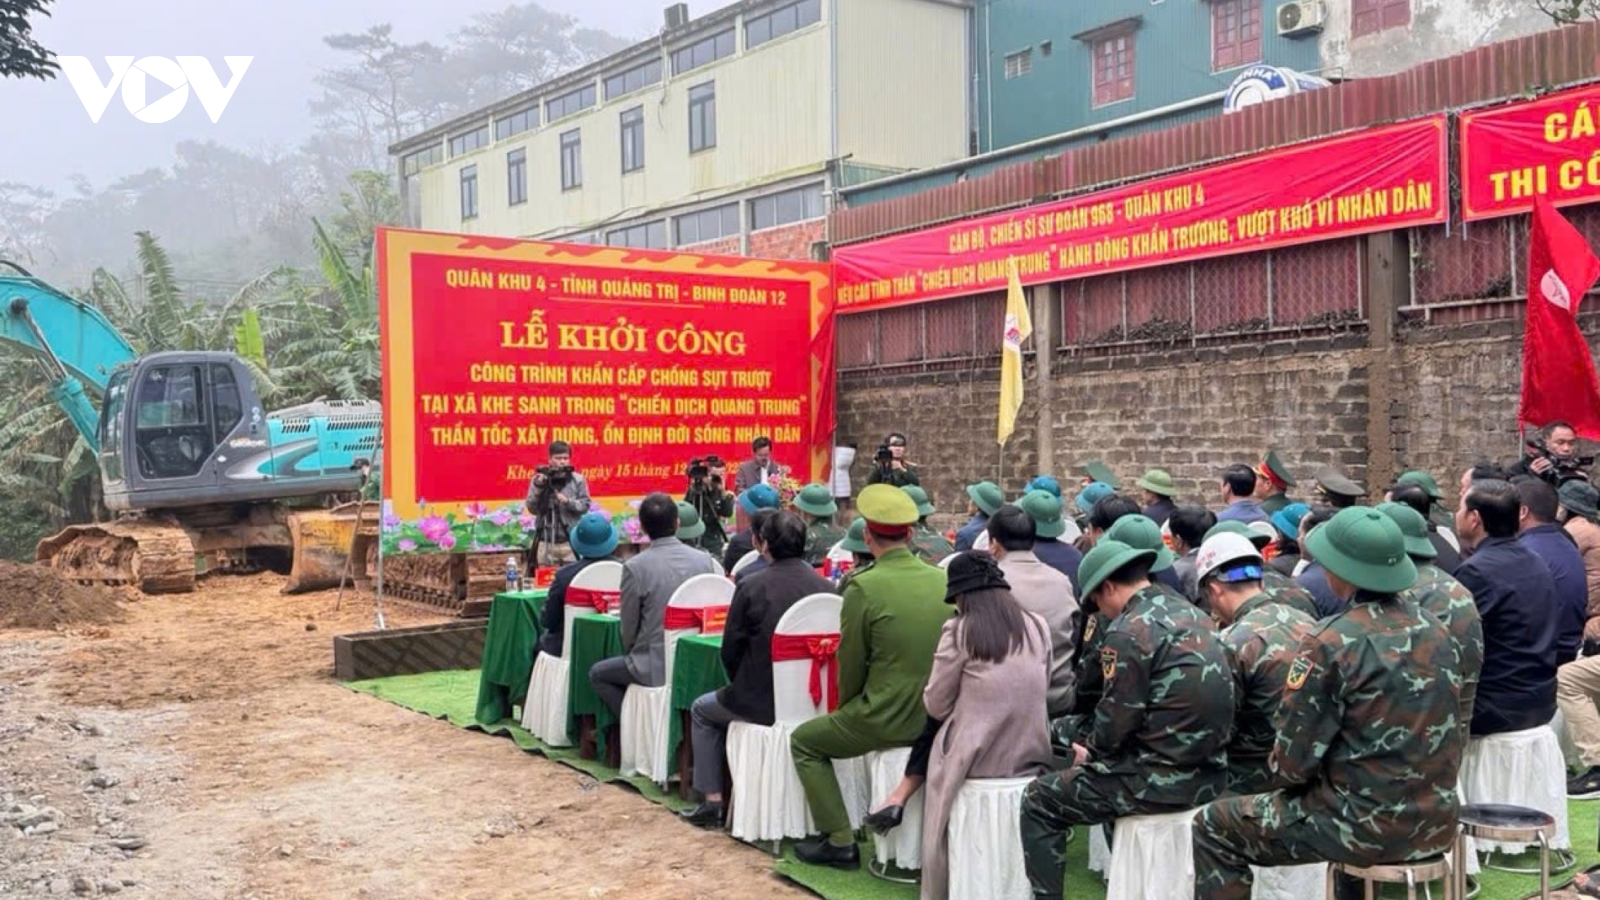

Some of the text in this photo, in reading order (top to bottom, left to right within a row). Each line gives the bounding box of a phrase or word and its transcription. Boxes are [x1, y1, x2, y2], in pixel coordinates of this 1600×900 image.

[1544, 101, 1600, 143] CÁ
[1489, 165, 1547, 201] THI
[990, 218, 1023, 246] CHIẾN
[1038, 211, 1053, 237] SƯ
[1056, 205, 1088, 233] ĐOÀN
[1090, 202, 1114, 227] 968
[1125, 190, 1160, 222] QUÂN
[1164, 184, 1192, 212] KHU
[1196, 183, 1205, 206] 4
[871, 278, 892, 300] TINH
[952, 262, 976, 290] DỊCH
[1059, 243, 1092, 269] HÀNH
[1094, 236, 1129, 266] ĐỘNG
[1172, 218, 1233, 250] TRƯƠNG,
[1237, 209, 1276, 242] VƯỢT
[1280, 198, 1313, 233] KHÓ
[1316, 194, 1332, 227] VÌ
[1337, 188, 1388, 223] NHÂN
[1392, 180, 1432, 214] DÂN
[446, 268, 493, 288] QUÂN
[498, 273, 531, 290] KHU
[536, 276, 546, 291] 4
[561, 273, 597, 294] TỈNH
[602, 277, 652, 298] QUẢNG
[656, 282, 679, 303] TRỊ
[693, 285, 726, 303] BINH
[729, 285, 766, 304] ĐOÀN
[770, 291, 786, 306] 12
[500, 309, 746, 355] LỄ KHỞI CÔNG
[470, 361, 516, 382] CÔNG
[520, 363, 567, 384] TRÌNH
[617, 363, 646, 385] CẤP
[651, 364, 698, 386] CHỐNG
[703, 370, 728, 391] SỤT
[731, 370, 772, 391] TRƯỢT
[421, 395, 449, 418] TẠI
[454, 392, 477, 414] XÃ
[482, 396, 513, 414] KHE
[518, 396, 561, 414] SANH
[565, 397, 615, 415] TRONG
[675, 398, 707, 419] DỊCH
[711, 398, 754, 417] QUANG
[517, 424, 547, 445] XÂY
[628, 426, 662, 448] ĐỊNH
[666, 423, 690, 444] ĐỜI
[694, 421, 730, 444] SỐNG
[735, 423, 770, 442] NHÂN
[774, 423, 801, 442] DÂN
[507, 464, 535, 480] Khe
[580, 466, 611, 482] ngày
[616, 464, 630, 476] 15
[633, 463, 669, 478] tháng
